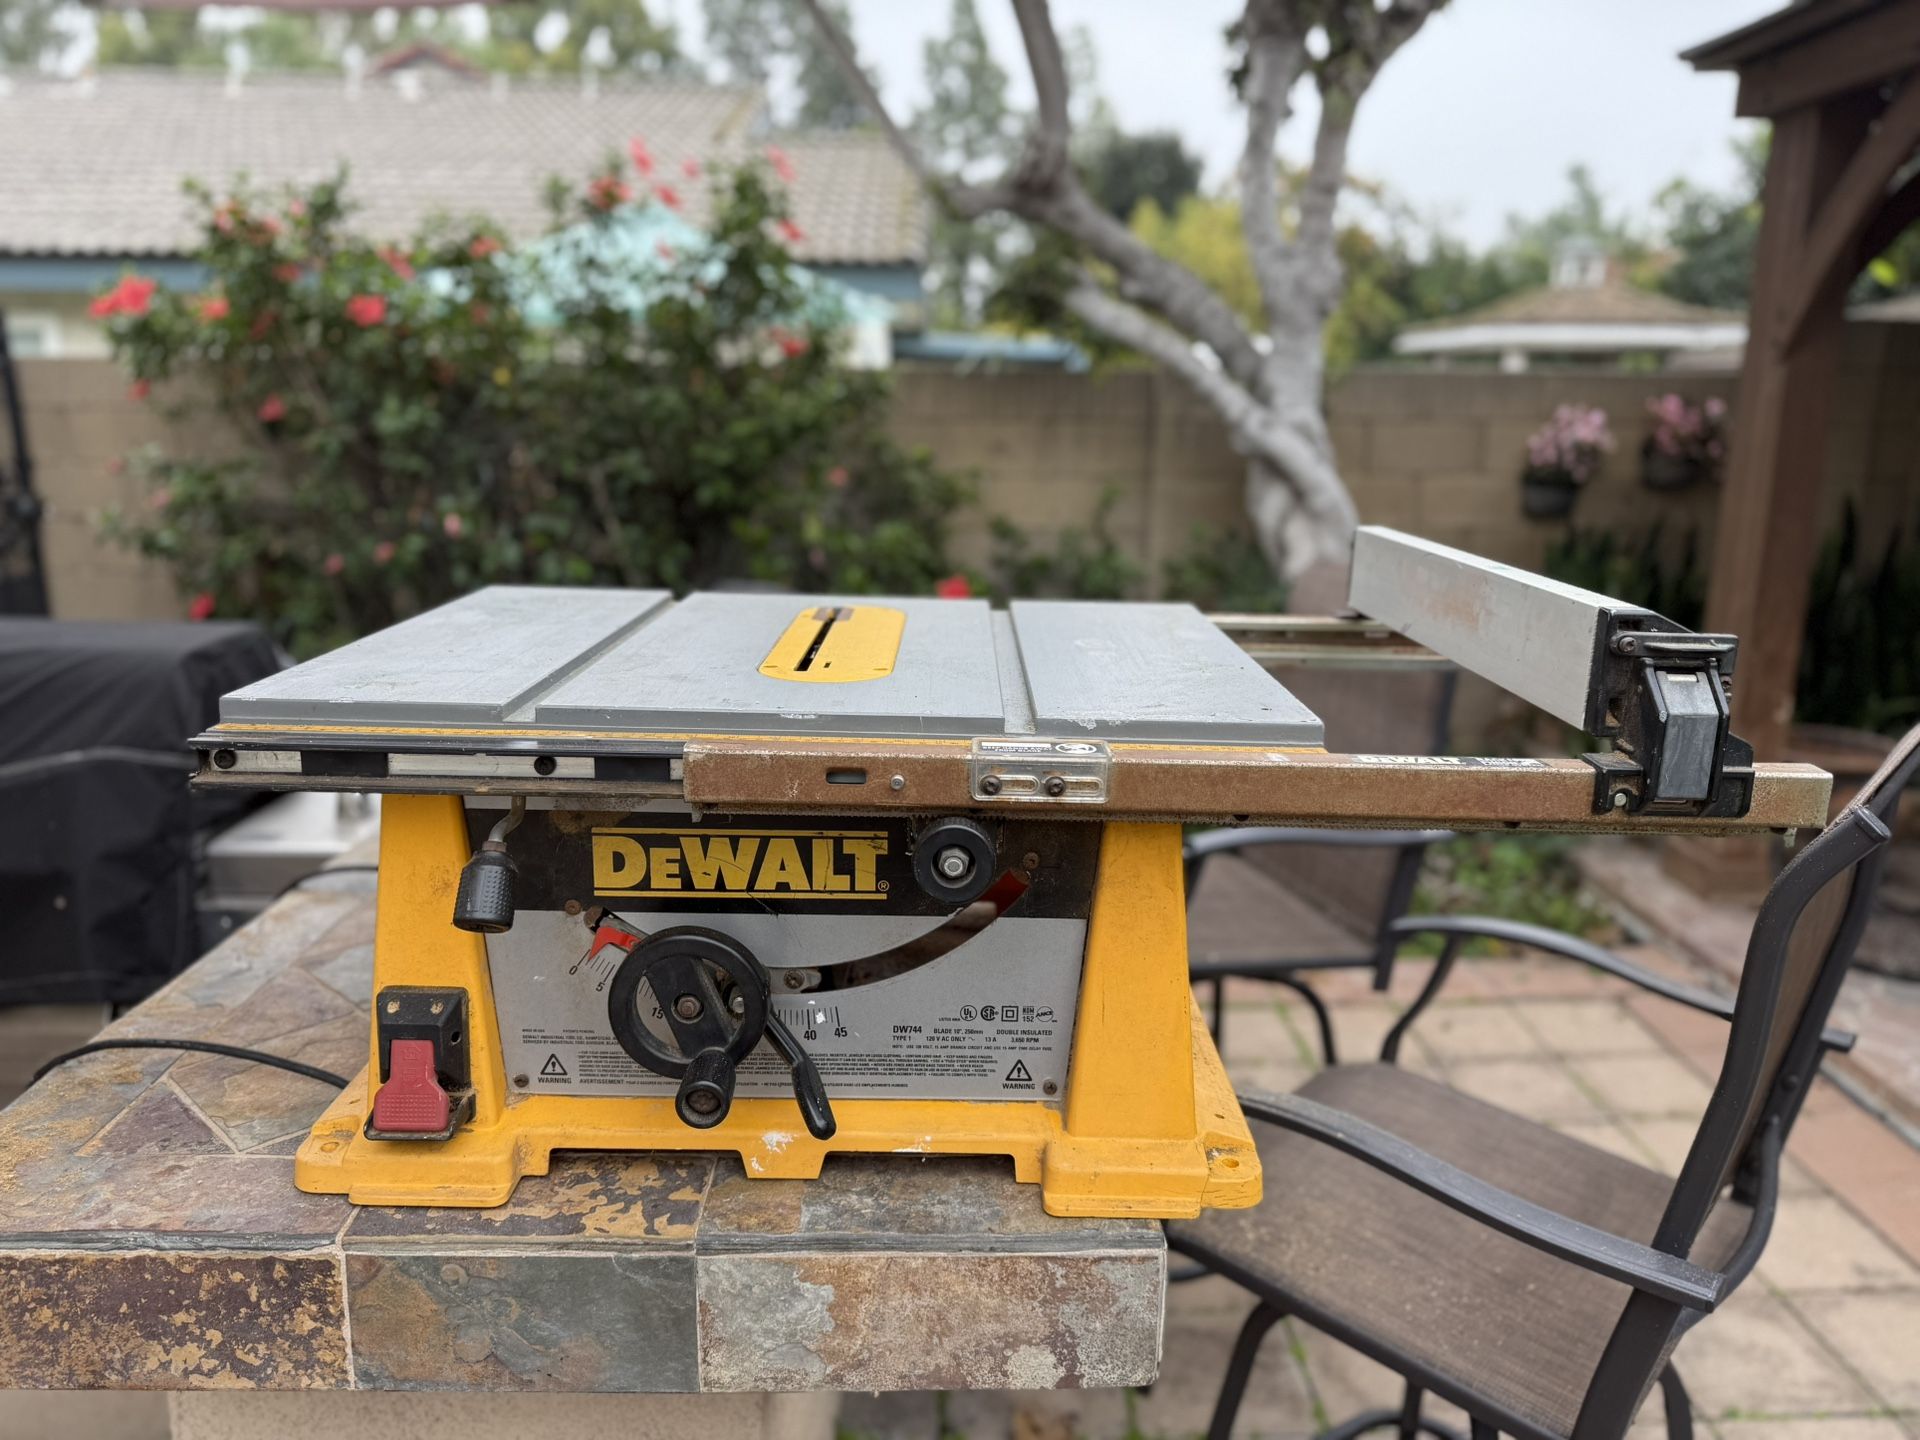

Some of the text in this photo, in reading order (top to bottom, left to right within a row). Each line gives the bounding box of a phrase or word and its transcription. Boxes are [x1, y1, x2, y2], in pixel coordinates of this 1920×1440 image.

[569, 965, 578, 976] 0
[596, 981, 605, 992] 5
[651, 1006, 664, 1020] 15
[804, 1029, 817, 1041] 40
[834, 1026, 848, 1038] 45
[892, 1025, 922, 1034] DW744
[1002, 1082, 1036, 1090] WARNING
